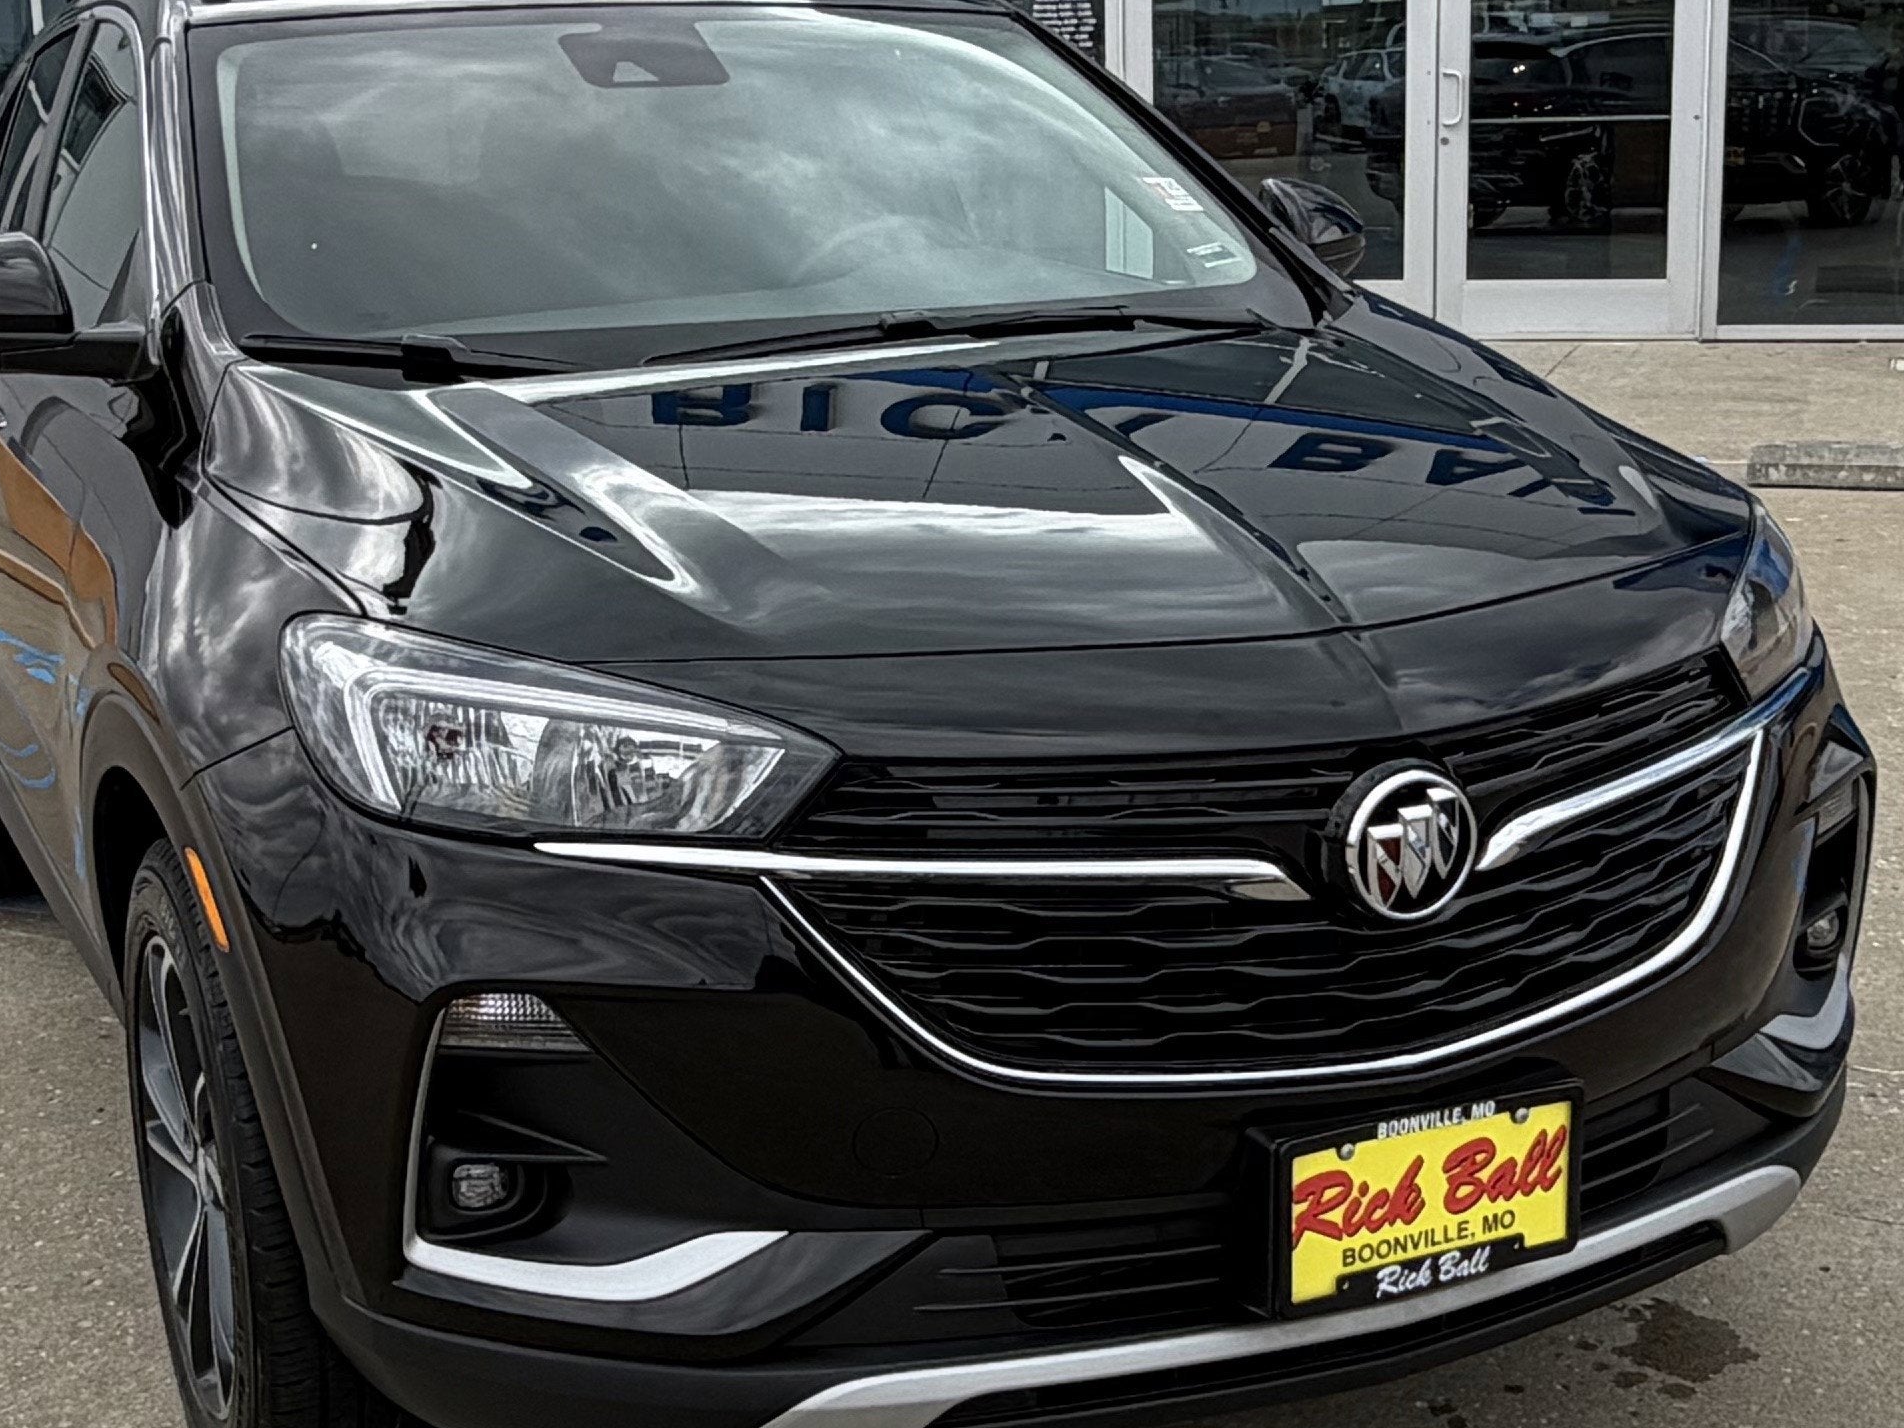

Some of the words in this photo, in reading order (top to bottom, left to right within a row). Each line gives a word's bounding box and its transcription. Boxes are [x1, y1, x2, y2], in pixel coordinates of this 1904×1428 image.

[1377, 1107, 1468, 1139] BOONVILLE,
[1471, 1100, 1496, 1119] MO
[1292, 1155, 1426, 1250] Rick
[1442, 1124, 1568, 1215] Ball
[1341, 1219, 1477, 1268] BOONVILLE,
[1482, 1209, 1516, 1233] MO
[1376, 1259, 1434, 1300] Rick
[1438, 1247, 1490, 1283] Ball
